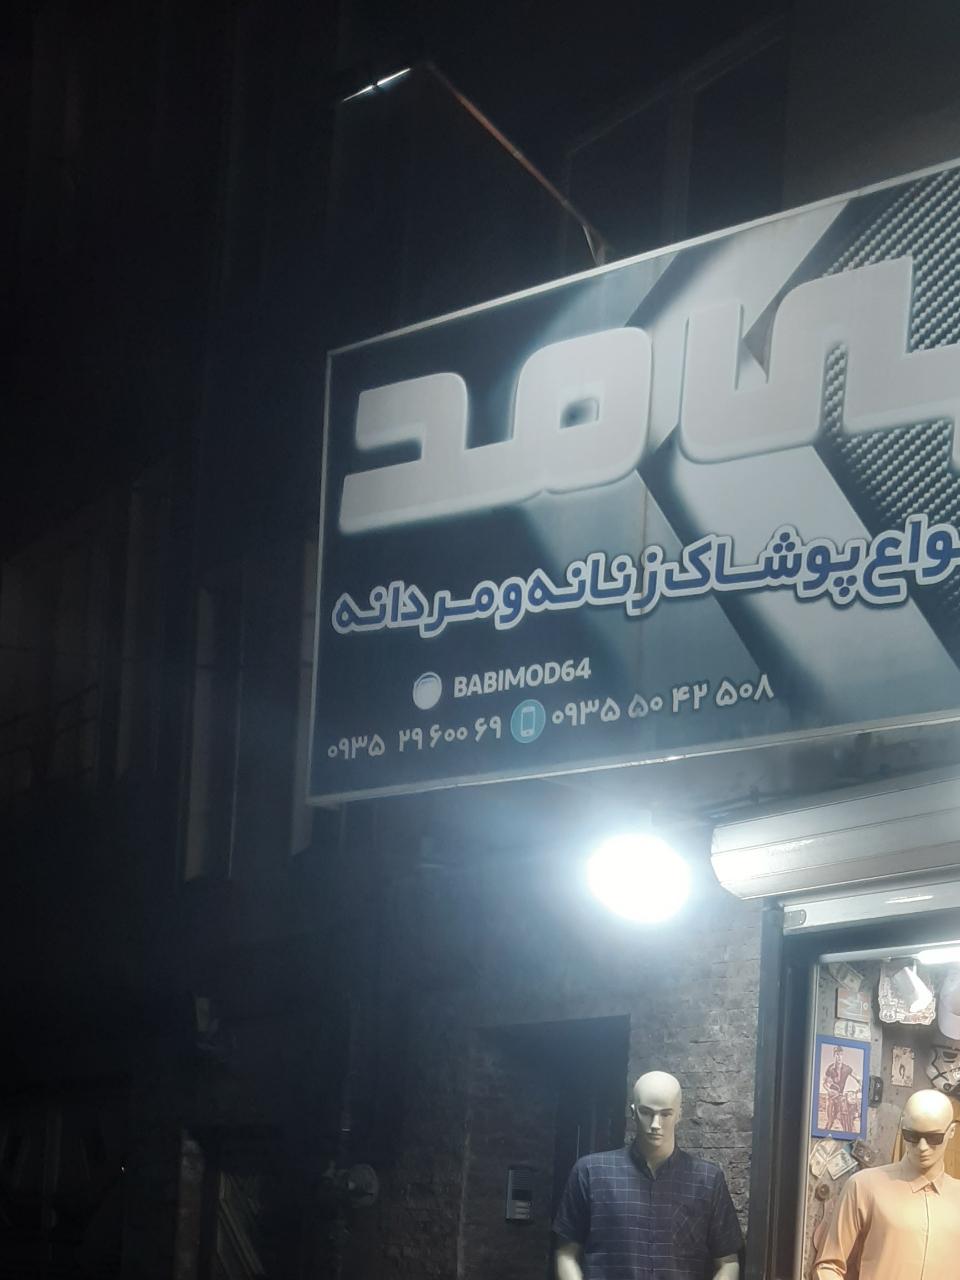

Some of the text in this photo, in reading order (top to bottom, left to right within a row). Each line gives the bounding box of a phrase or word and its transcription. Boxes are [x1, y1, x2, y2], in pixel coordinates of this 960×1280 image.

[526, 545, 664, 616] زنانه
[663, 525, 868, 604] پوشاک
[332, 580, 497, 638] مردانه
[453, 656, 592, 698] BABIMOD64
